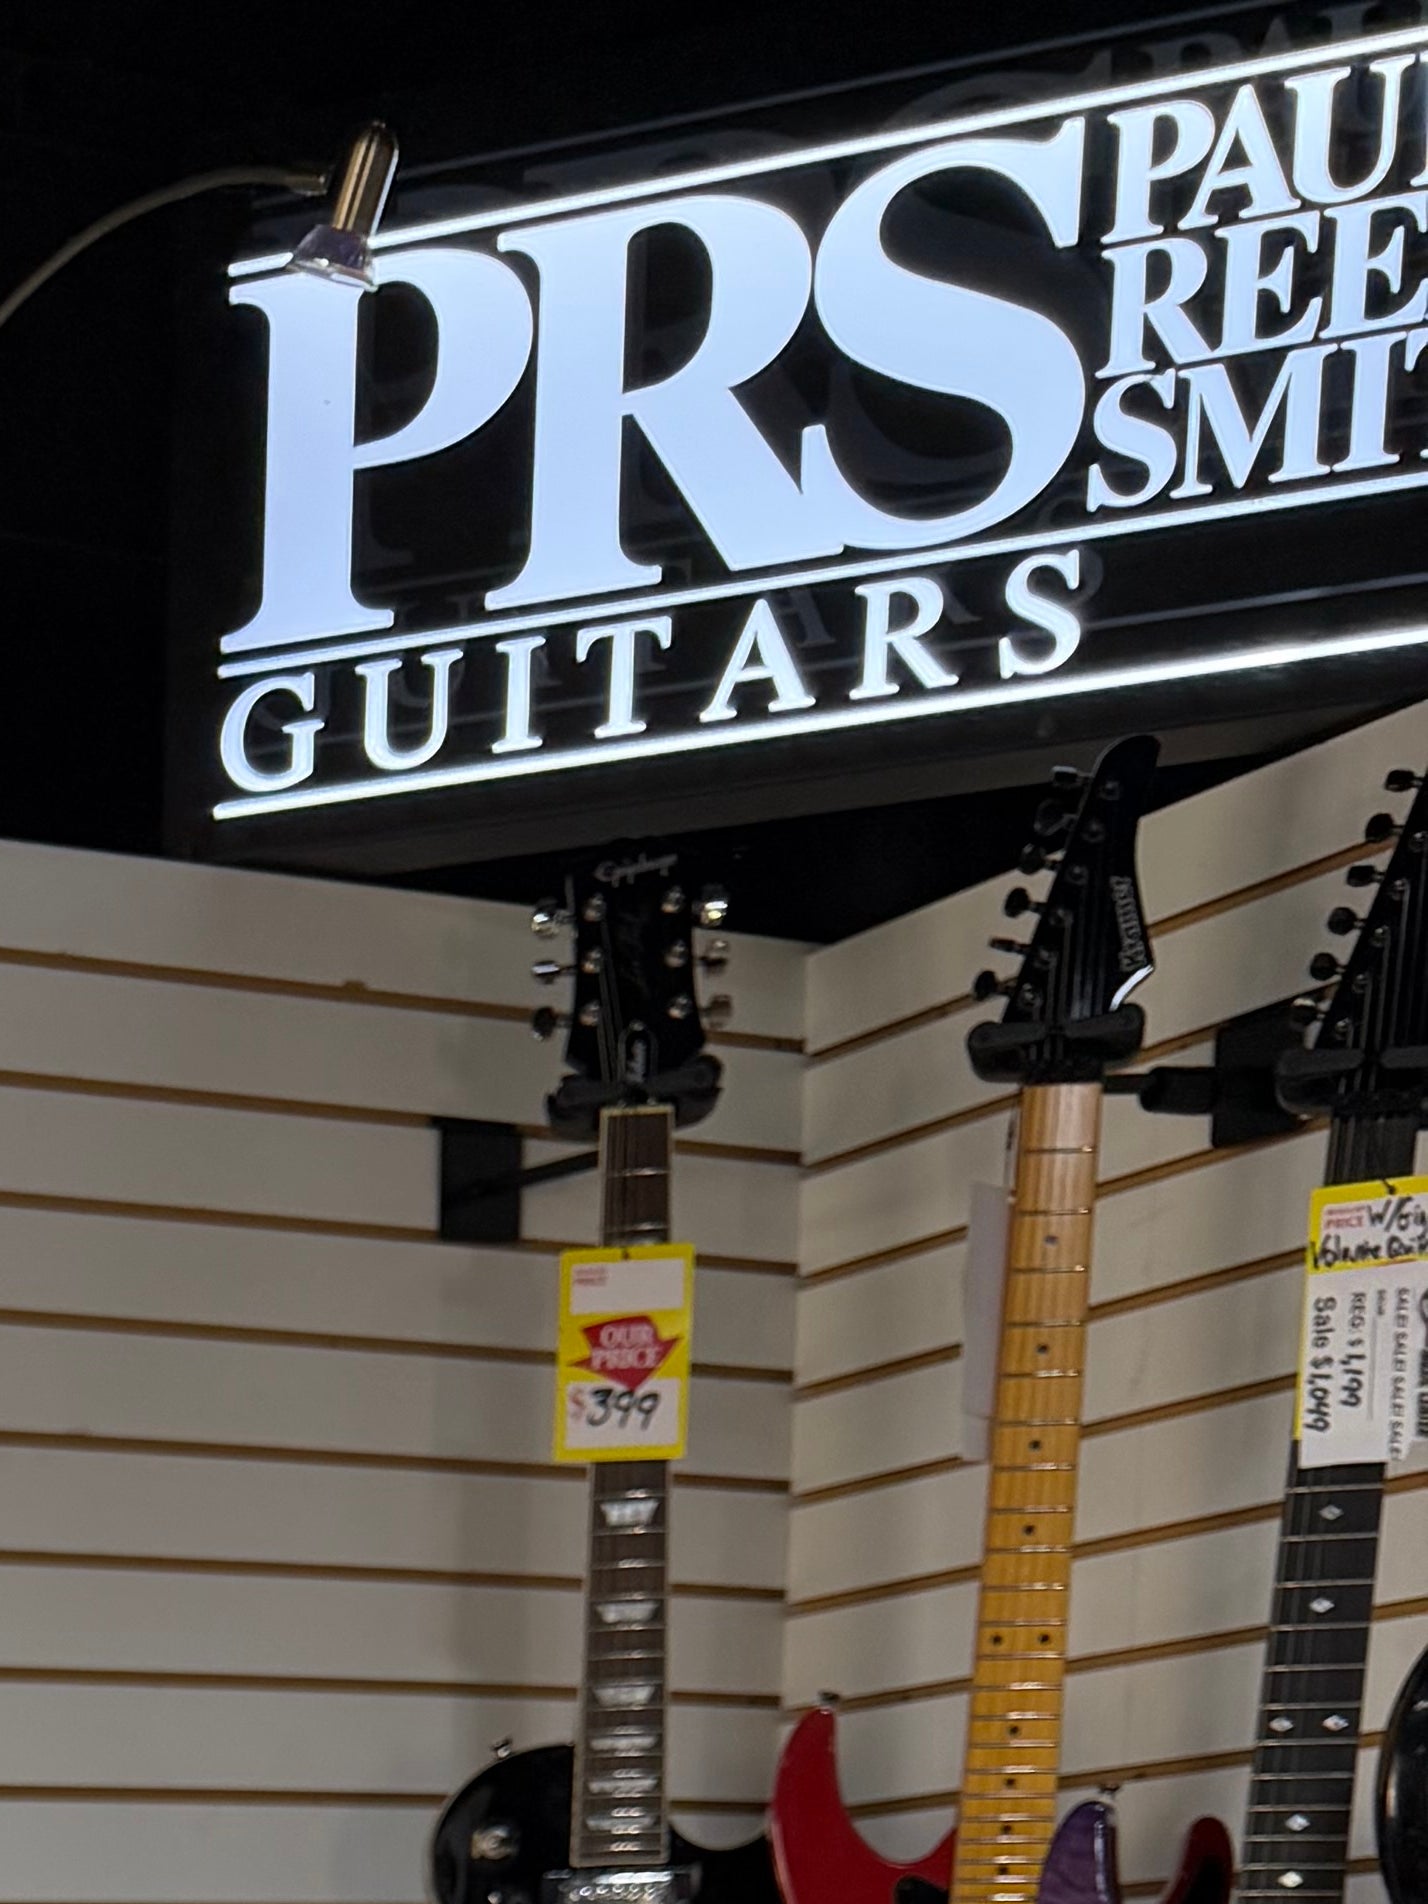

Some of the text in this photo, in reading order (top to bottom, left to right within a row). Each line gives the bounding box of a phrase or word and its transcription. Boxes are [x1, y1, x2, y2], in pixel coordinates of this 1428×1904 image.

[1101, 54, 1428, 244] PAU
[1096, 189, 1428, 379] REE
[221, 117, 1086, 654] PRS
[1086, 330, 1428, 513] SMI
[221, 549, 1083, 793] GUITARS
[590, 1346, 663, 1370] PRICE
[599, 1321, 655, 1349] OUR
